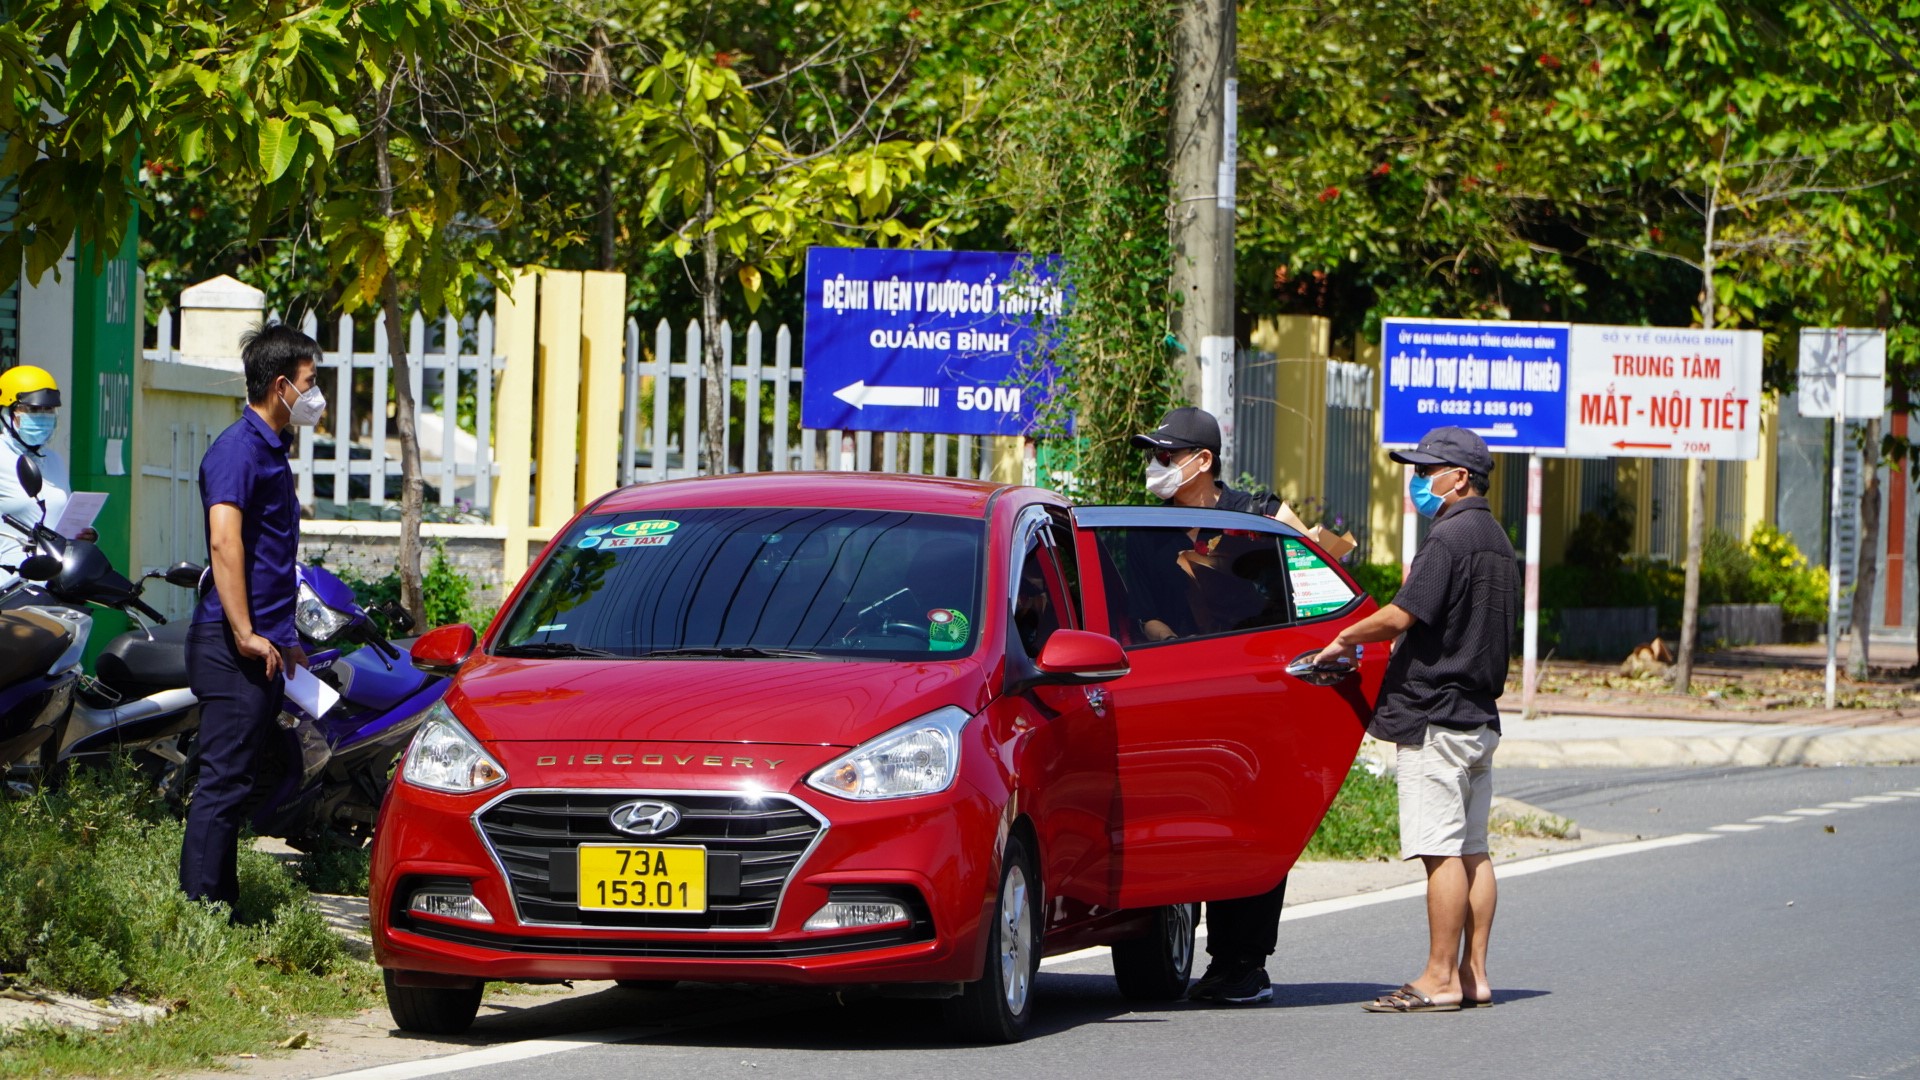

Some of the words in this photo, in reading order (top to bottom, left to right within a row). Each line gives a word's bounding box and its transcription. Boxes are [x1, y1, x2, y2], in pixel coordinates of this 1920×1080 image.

[823, 273, 869, 316] BỆNH
[873, 275, 912, 317] VIỆN
[914, 281, 926, 312] Y
[970, 272, 997, 314] CỔ
[869, 323, 950, 350] QUẢNG
[957, 329, 1010, 352] BÌNH
[1623, 333, 1631, 343] Y
[1458, 353, 1490, 394] BỆNH
[1490, 355, 1523, 391] NHÂN
[1612, 354, 1675, 378] TRUNG
[1680, 353, 1721, 379] TÂM
[956, 386, 1021, 413] 50M
[1472, 400, 1483, 416] 3
[1650, 390, 1692, 434] NỘI
[1700, 386, 1749, 431] TIẾT
[1683, 441, 1711, 453] 70M
[608, 538, 628, 547] XE
[633, 536, 665, 546] TAXI
[536, 754, 785, 770] DISCOVERY
[615, 850, 669, 876] 73A
[596, 880, 689, 908] 153.01
